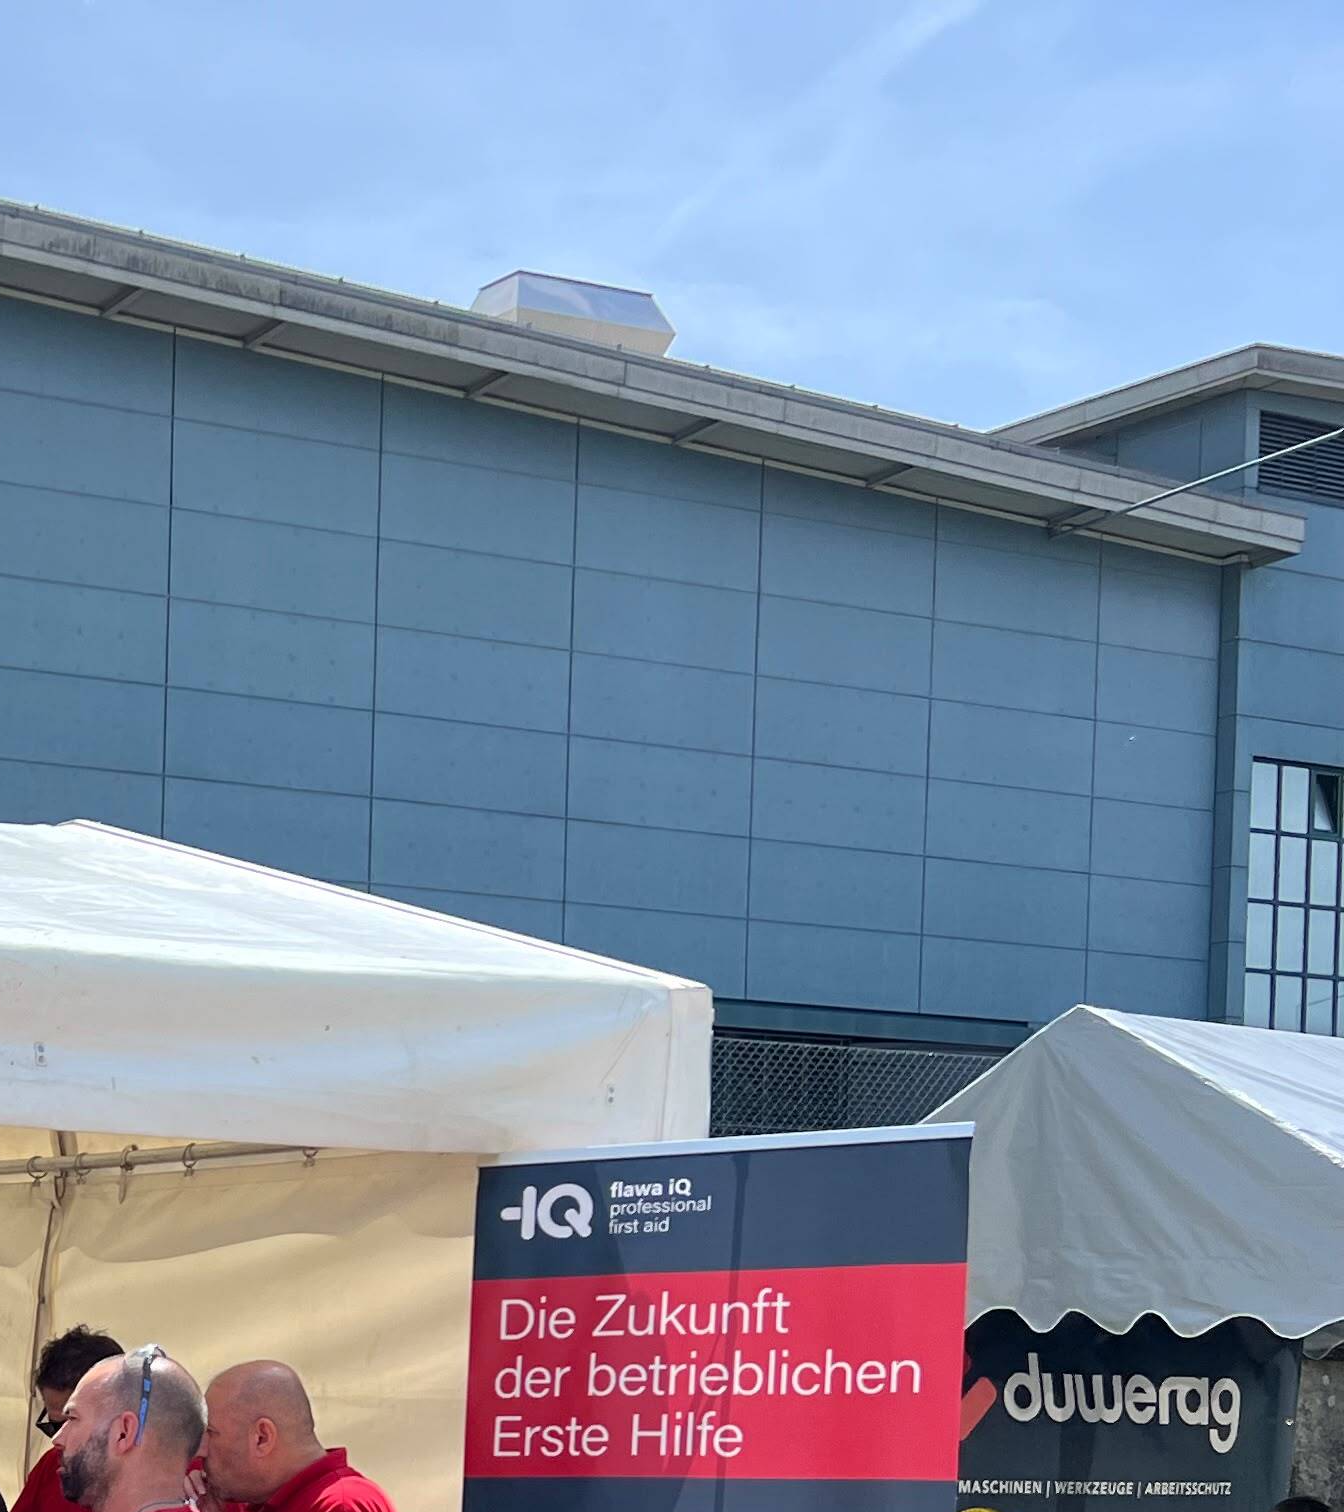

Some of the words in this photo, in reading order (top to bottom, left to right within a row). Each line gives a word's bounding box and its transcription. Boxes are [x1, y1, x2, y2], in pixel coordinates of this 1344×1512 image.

[610, 1181, 663, 1198] flawa
[668, 1178, 692, 1197] iQ
[609, 1195, 713, 1219] professional
[609, 1218, 639, 1235] first
[643, 1217, 670, 1233] aid
[499, 1296, 577, 1341] Die
[591, 1287, 791, 1337] Zukunft
[494, 1355, 571, 1399] der
[587, 1349, 921, 1398] betrieblichen
[1003, 1352, 1242, 1454] duwerag
[492, 1415, 609, 1458] Erste
[630, 1411, 743, 1458] Hilfe
[957, 1480, 1042, 1495] MASCHINEN
[1054, 1481, 1134, 1496] WERKZEUGE
[1144, 1482, 1232, 1496] ARBEITSSCHUTZ
